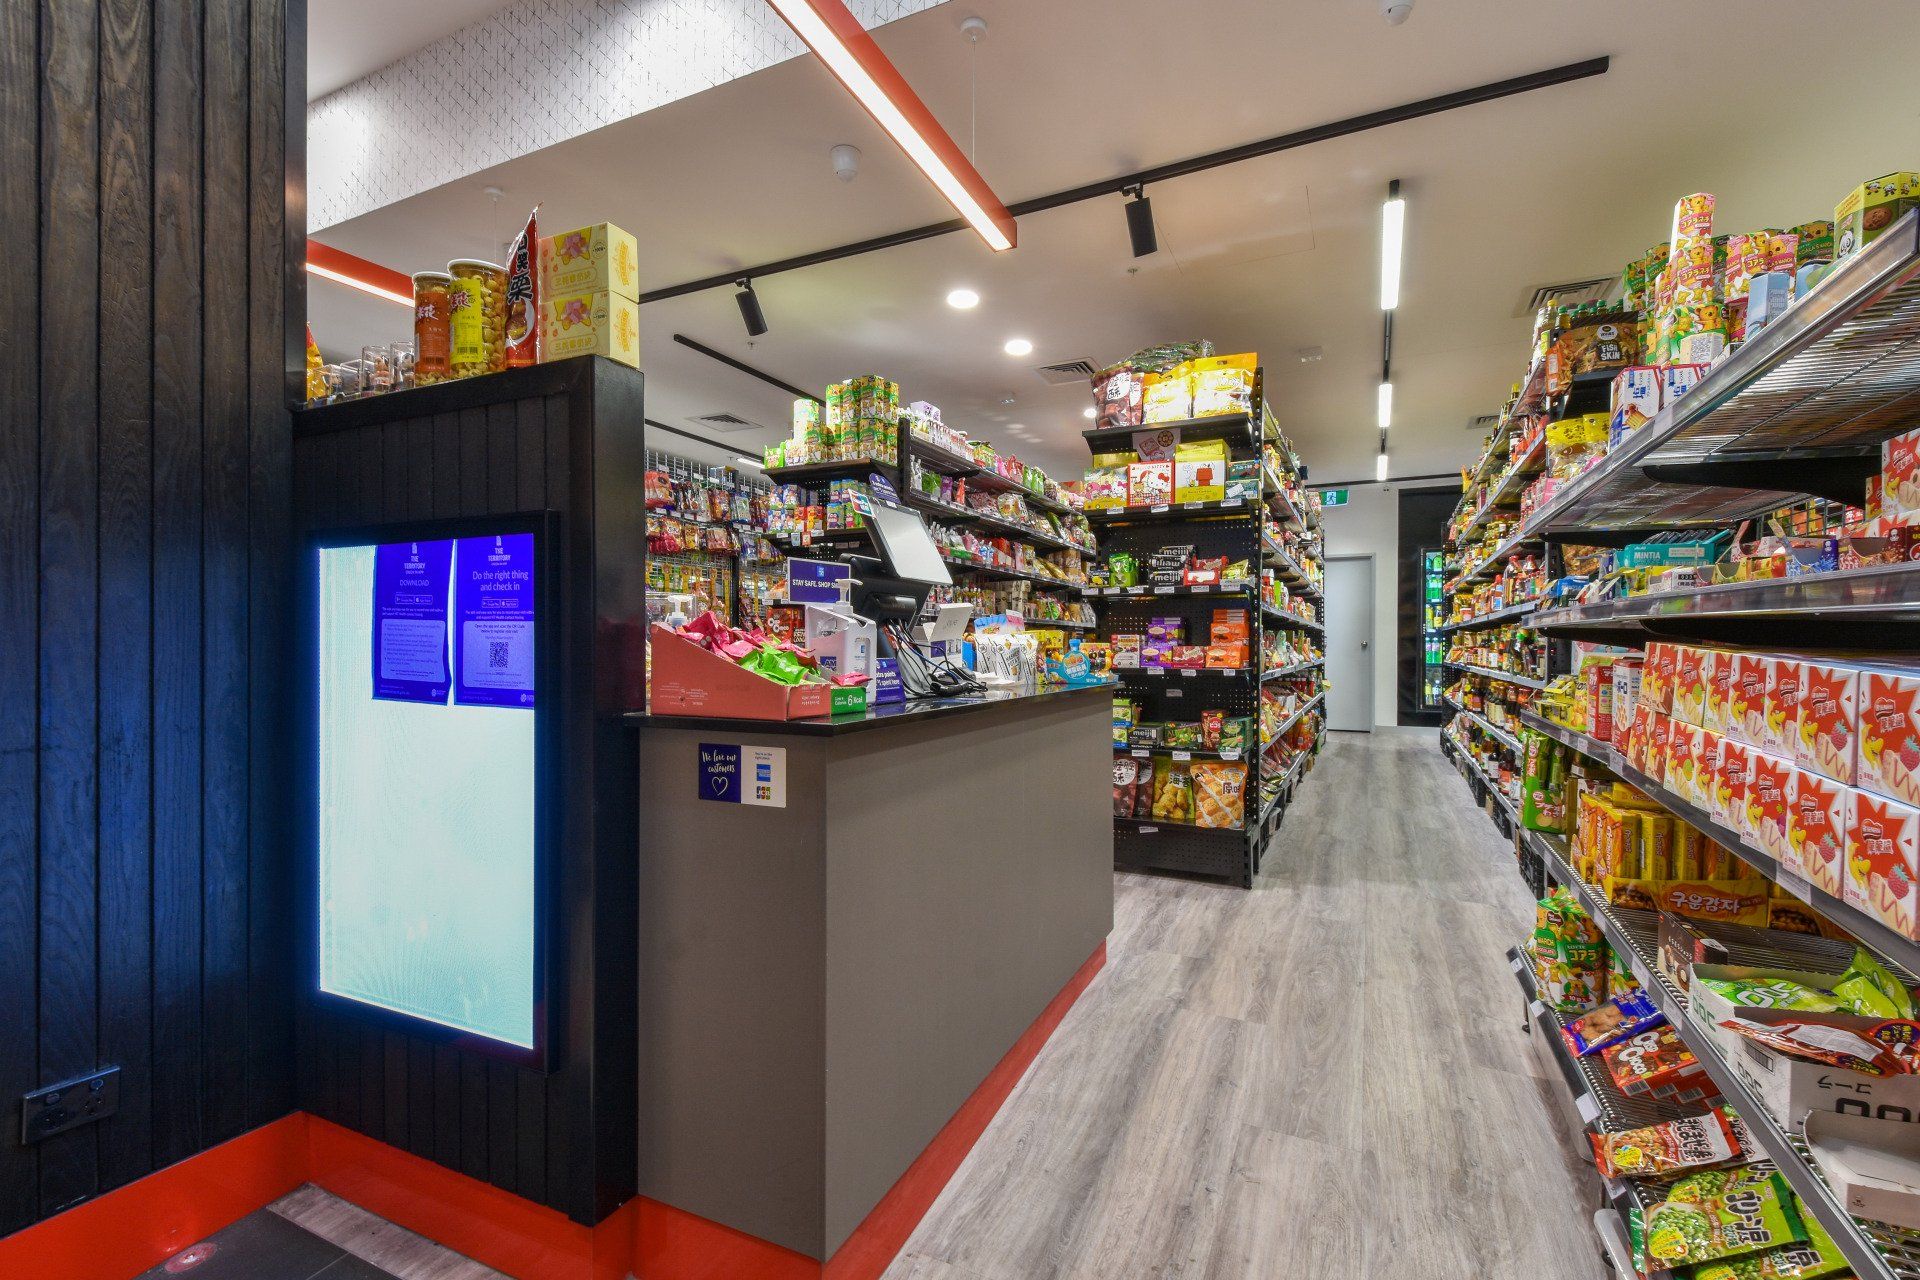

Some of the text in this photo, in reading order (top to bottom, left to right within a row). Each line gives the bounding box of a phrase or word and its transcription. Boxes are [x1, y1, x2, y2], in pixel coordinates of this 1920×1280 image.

[1601, 344, 1618, 352] FISH
[1600, 352, 1621, 361] SKIN
[1633, 551, 1661, 559] MINTIA
[472, 569, 529, 582] Do the right thing
[1154, 571, 1181, 582] meiji
[399, 579, 430, 587] DOWNLOAD
[480, 581, 520, 591] and check in
[792, 579, 805, 587] STAY
[818, 580, 831, 588] SHOP
[847, 694, 853, 706] 6
[1133, 729, 1152, 738] meiji
[702, 749, 736, 762] We love our
[708, 763, 735, 773] customers
[1669, 891, 1740, 914] 구운감자
[1816, 1075, 1872, 1095] コーラ
